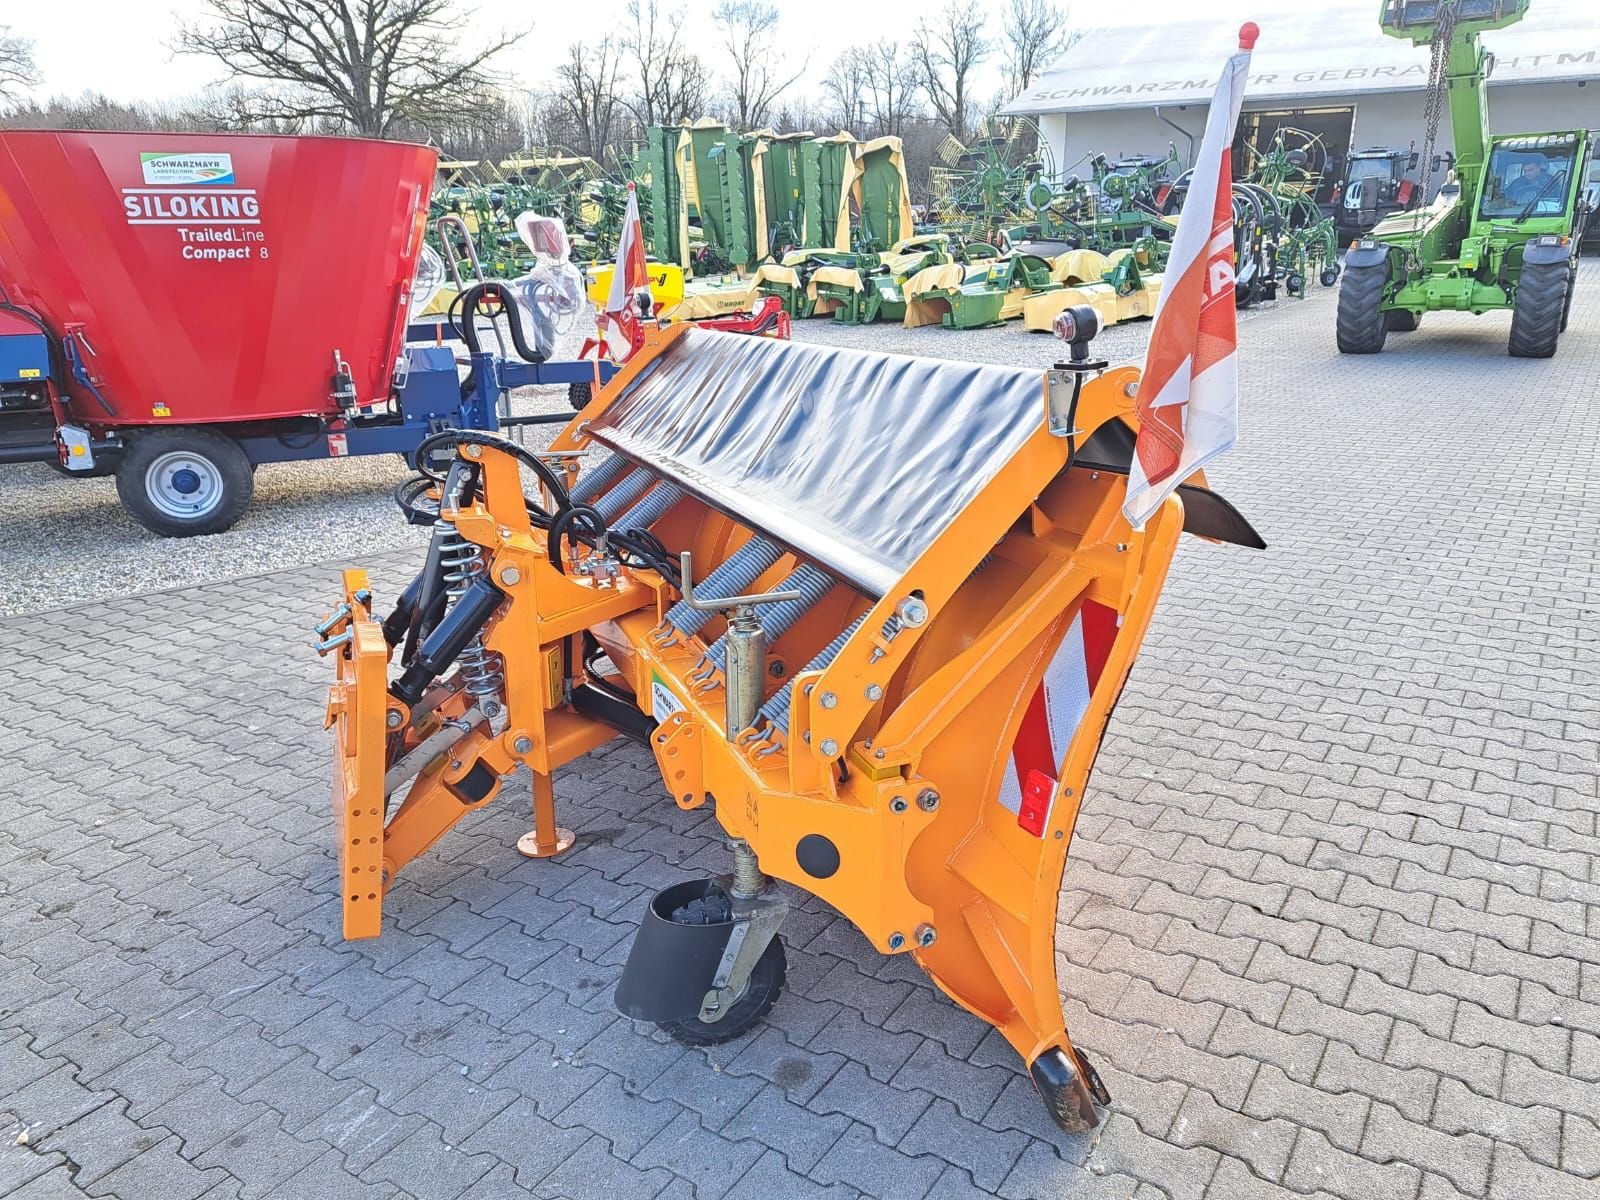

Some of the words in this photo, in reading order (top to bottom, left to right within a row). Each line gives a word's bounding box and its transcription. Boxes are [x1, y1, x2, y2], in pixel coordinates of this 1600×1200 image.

[1031, 74, 1279, 101] SCHWARZMR
[150, 160, 220, 168] SCHWARZMAYR
[124, 195, 259, 217] SILOKING
[177, 228, 265, 242] TrailedLine
[182, 246, 250, 262] Compact
[260, 247, 269, 259] 8
